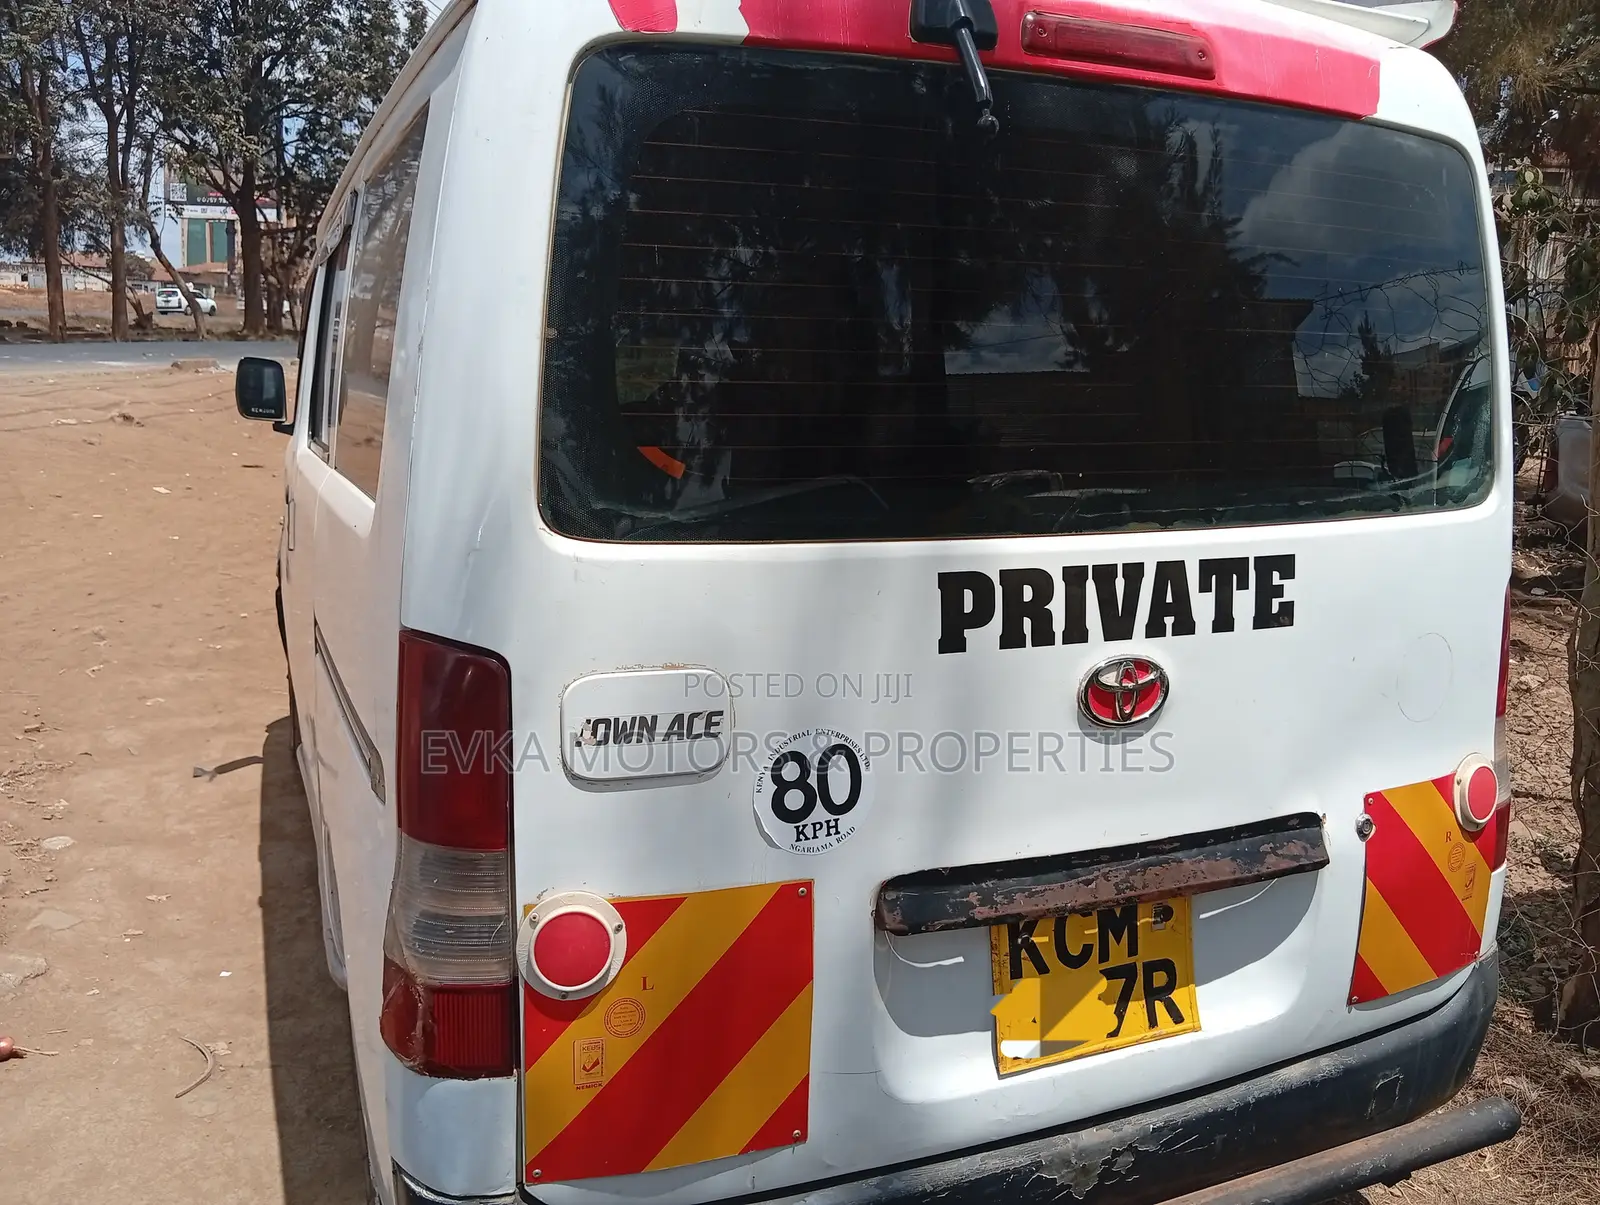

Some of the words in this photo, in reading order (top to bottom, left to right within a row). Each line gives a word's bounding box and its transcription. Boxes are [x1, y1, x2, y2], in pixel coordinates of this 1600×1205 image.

[938, 554, 1295, 654] PRIVATE
[662, 710, 724, 741] ACE
[755, 765, 769, 793] KENYA
[768, 729, 812, 762] INDUSTRIAL
[815, 728, 862, 754] ENTERPRISES
[771, 743, 863, 824] 80
[789, 842, 834, 853] NGARIAMA
[835, 826, 856, 844] ROAD
[794, 818, 841, 842] KPH
[1445, 831, 1452, 843] R
[1007, 901, 1140, 980] KCM
[642, 976, 655, 991] L
[576, 1082, 603, 1091] NEMICK
